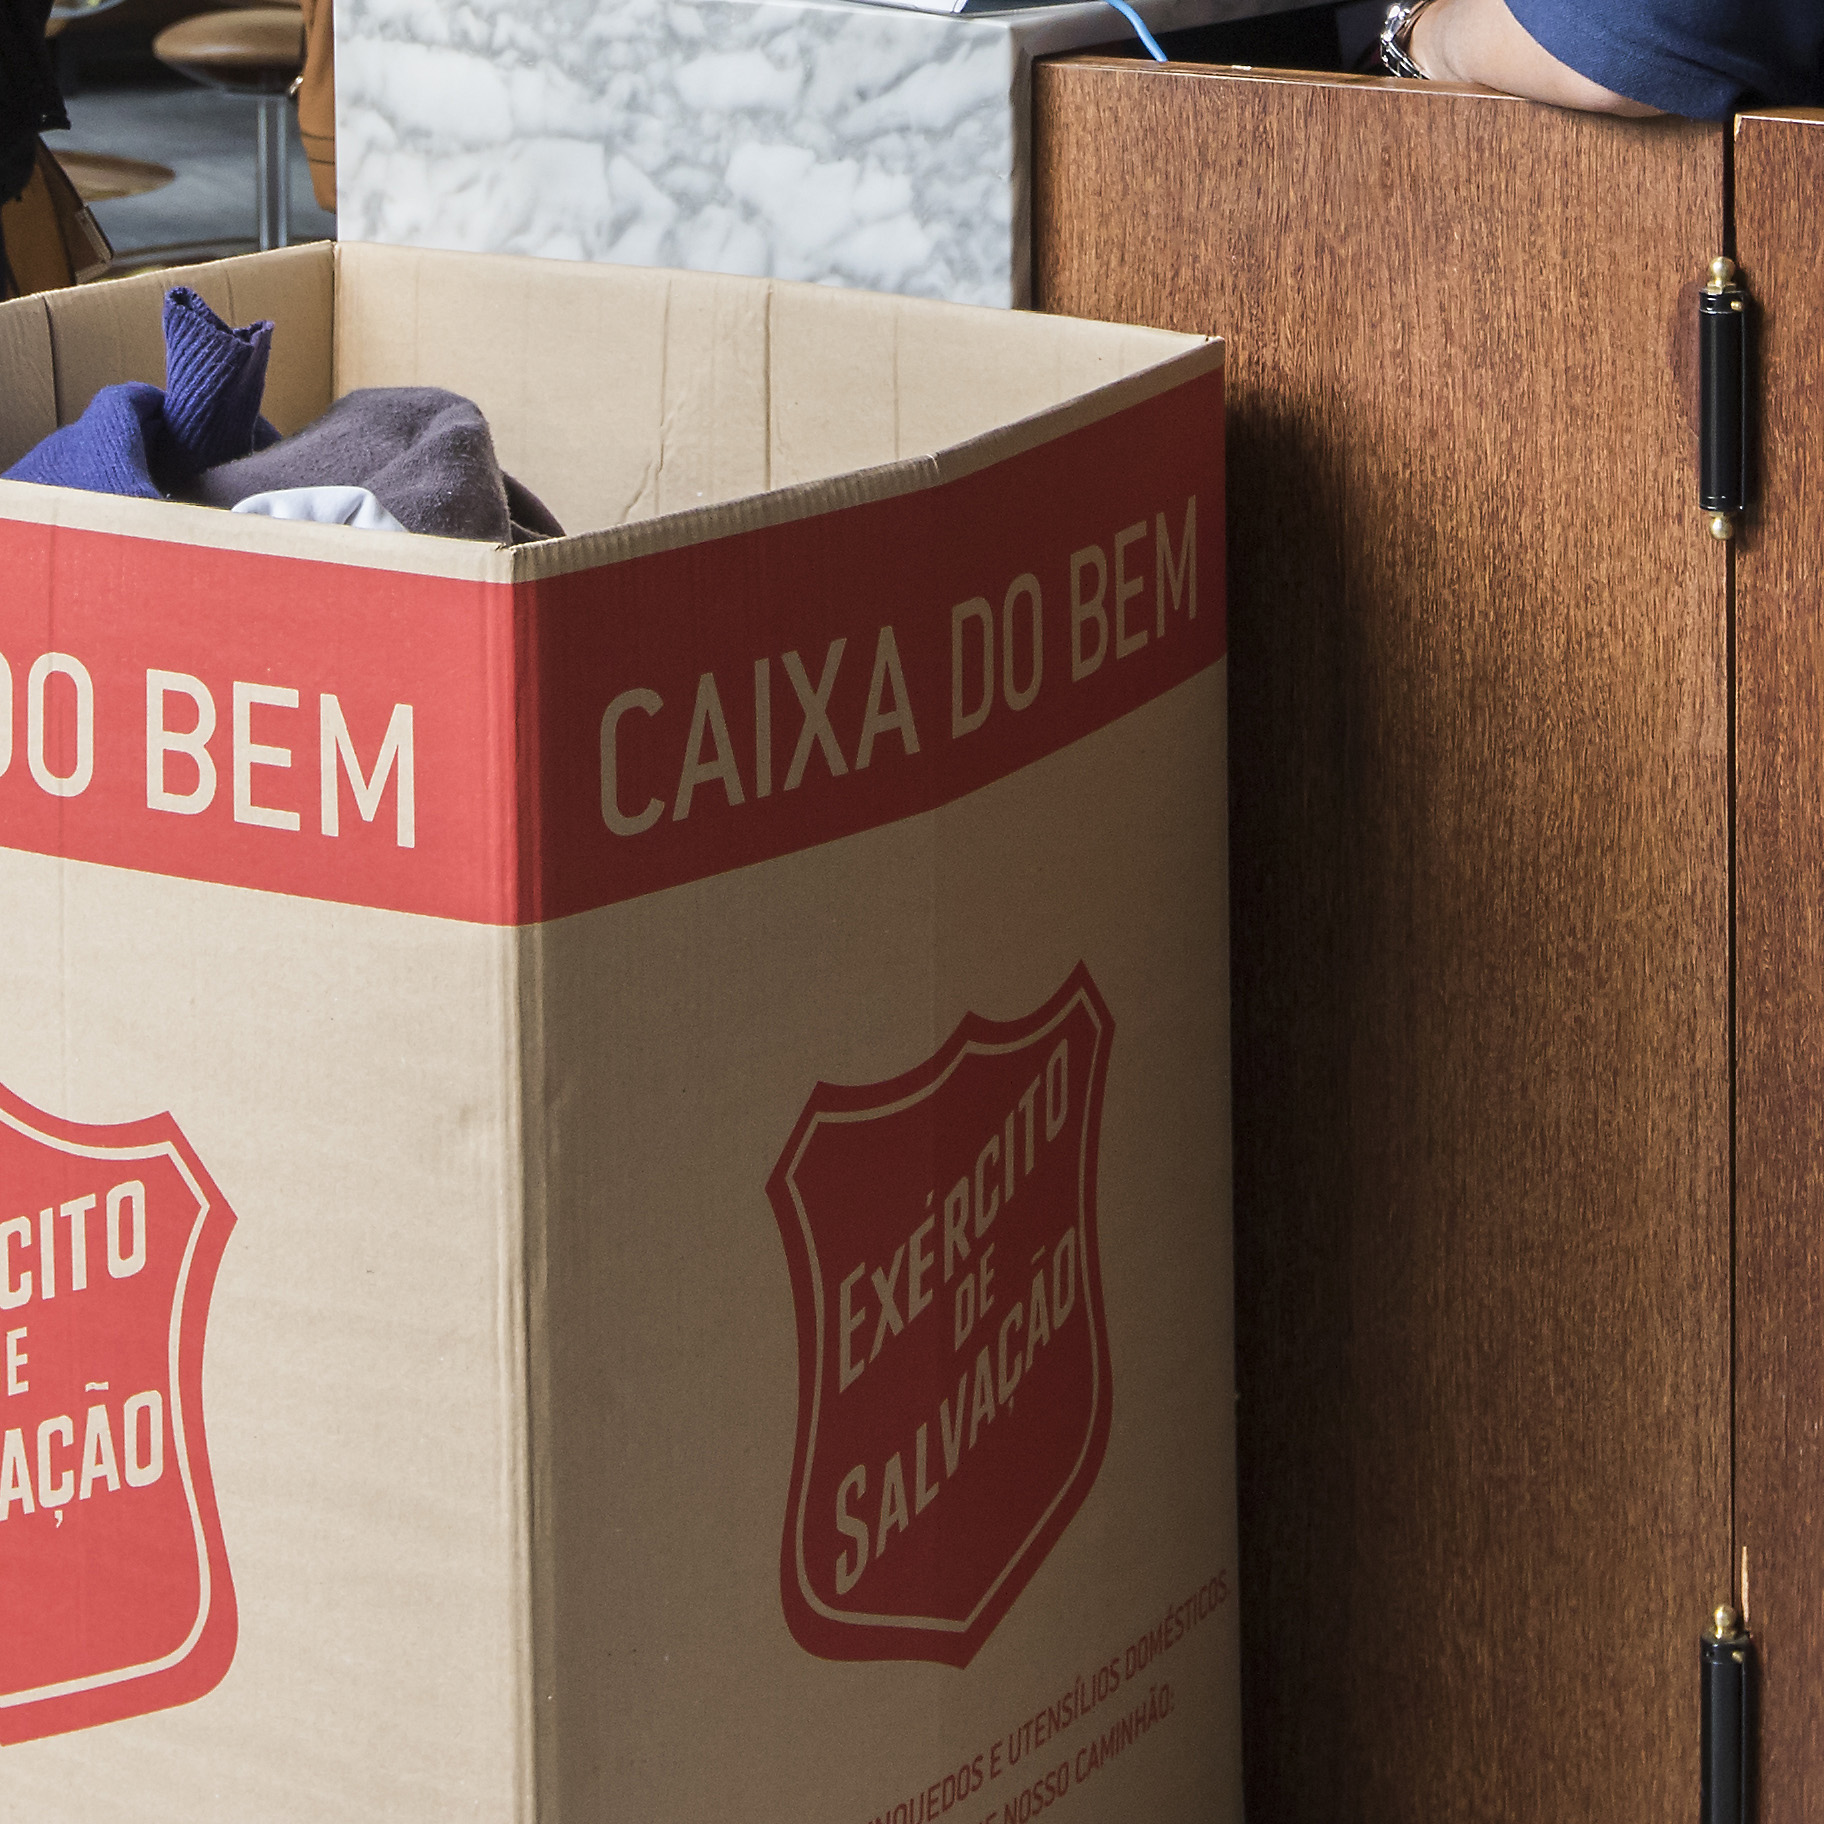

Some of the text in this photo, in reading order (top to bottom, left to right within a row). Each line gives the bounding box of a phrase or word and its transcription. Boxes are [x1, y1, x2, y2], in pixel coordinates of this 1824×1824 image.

[599, 496, 1198, 838] CAIXA DO BEM
[146, 668, 415, 849] BEM
[839, 1036, 1071, 1395] EXÉRCITO
[954, 1243, 996, 1354] DE
[833, 1226, 1077, 1597] SALVAÇÃO
[989, 1739, 1004, 1779] E
[1007, 1657, 1120, 1766] UTENSÍLIOS
[1003, 1761, 1070, 1824] NOSSO
